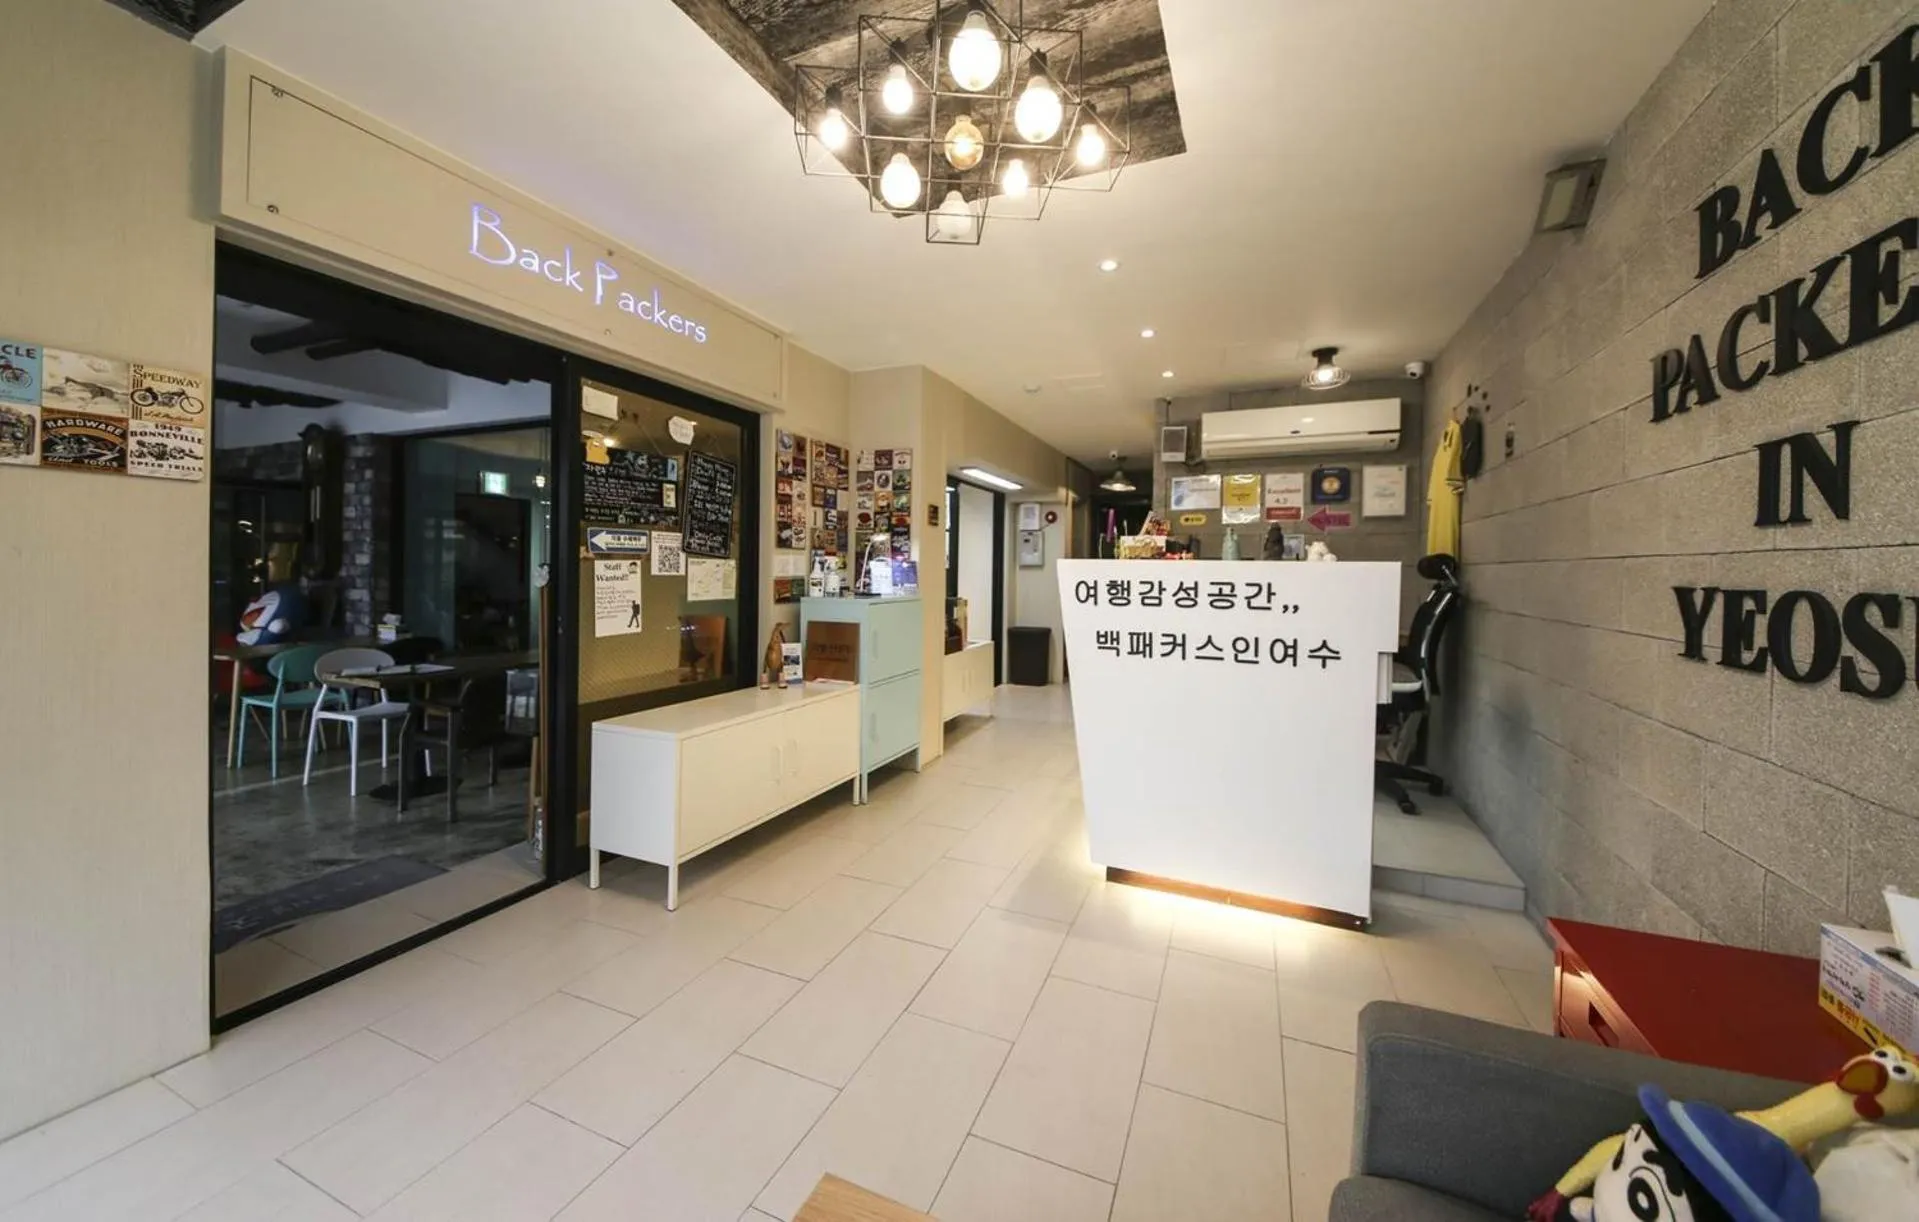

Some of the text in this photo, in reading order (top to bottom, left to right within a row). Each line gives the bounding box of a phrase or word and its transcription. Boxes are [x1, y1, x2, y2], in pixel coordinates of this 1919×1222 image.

[469, 202, 707, 344] Back Packers
[45, 418, 124, 436] HARDWARE
[129, 430, 205, 445] BONNEVILLE
[1754, 419, 1860, 528] IN
[603, 563, 622, 571] Staff
[1096, 629, 1342, 669] 백패커스인여수
[1672, 586, 1919, 700] YEOS
